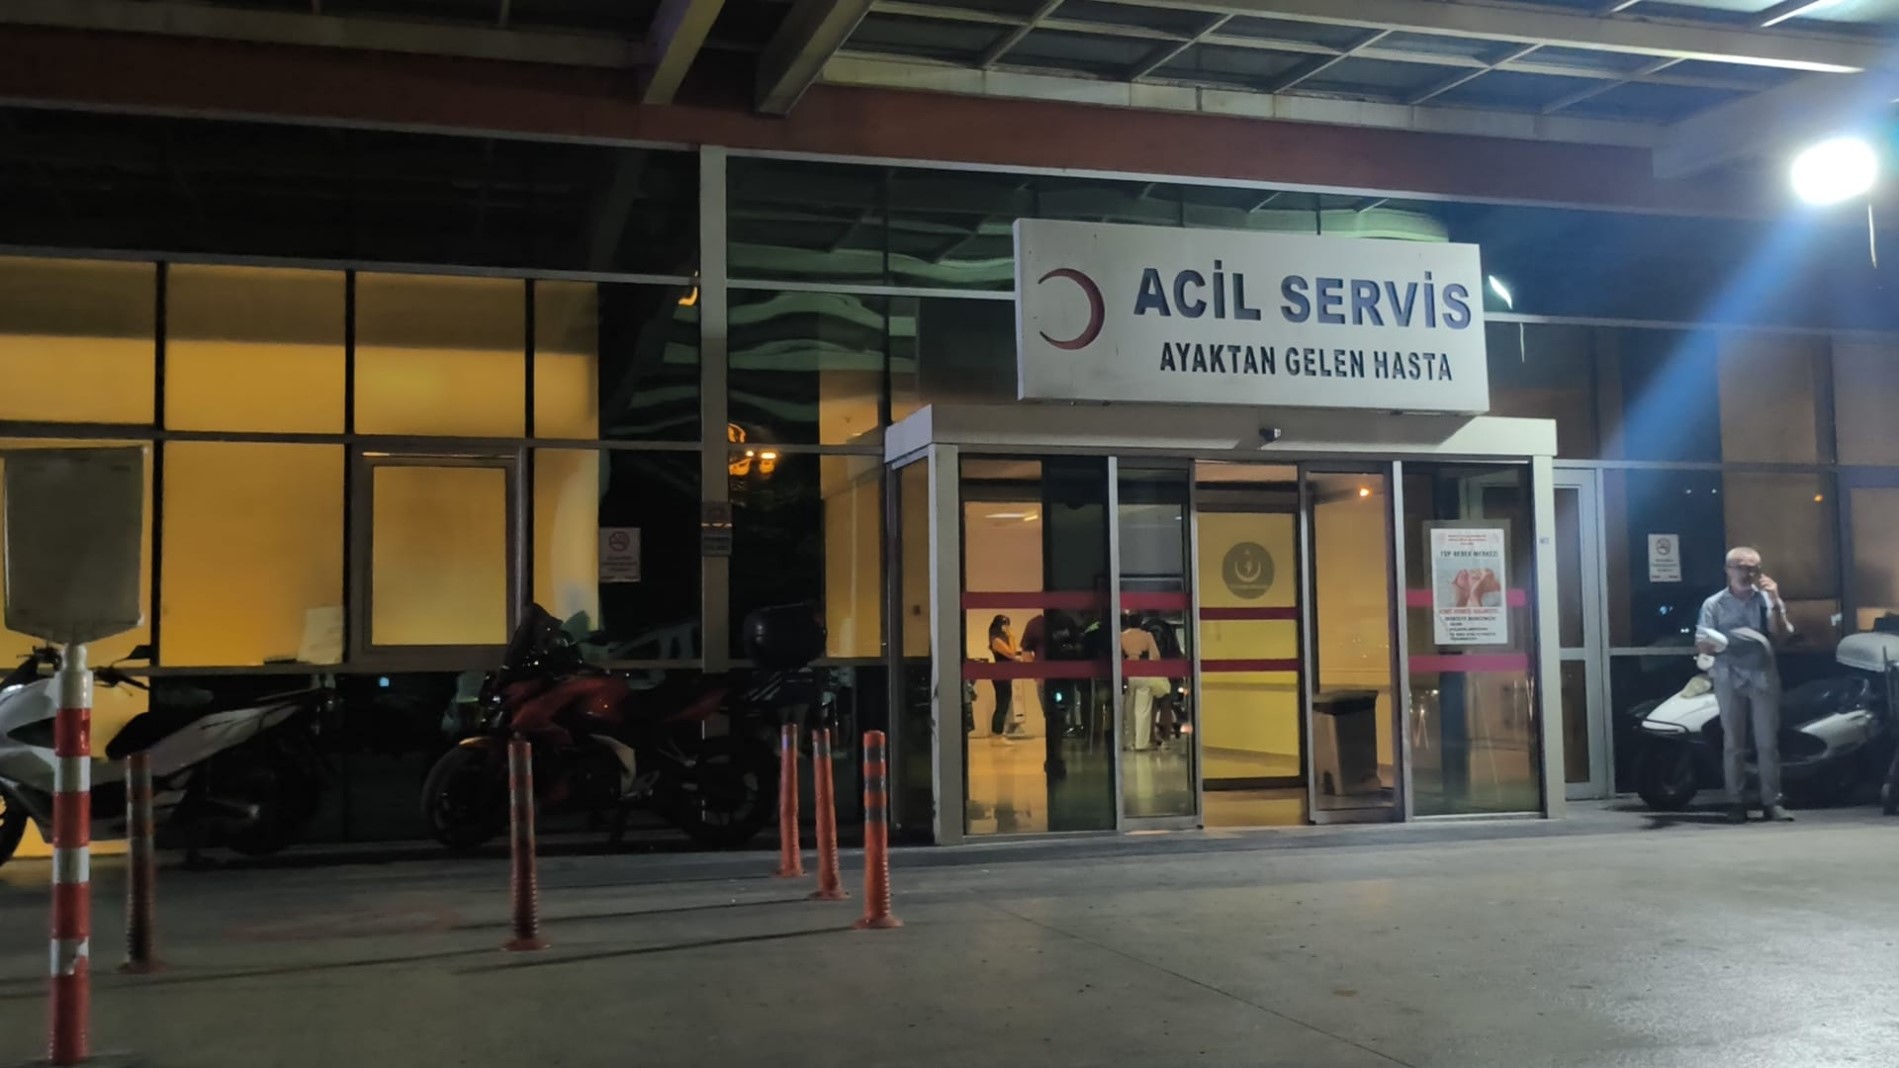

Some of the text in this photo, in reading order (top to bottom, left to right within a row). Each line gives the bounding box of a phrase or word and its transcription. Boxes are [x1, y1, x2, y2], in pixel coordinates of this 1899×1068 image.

[1134, 260, 1471, 330] ACİL SERVİS
[1160, 342, 1453, 382] AYAKTAN GELEN HASTA
